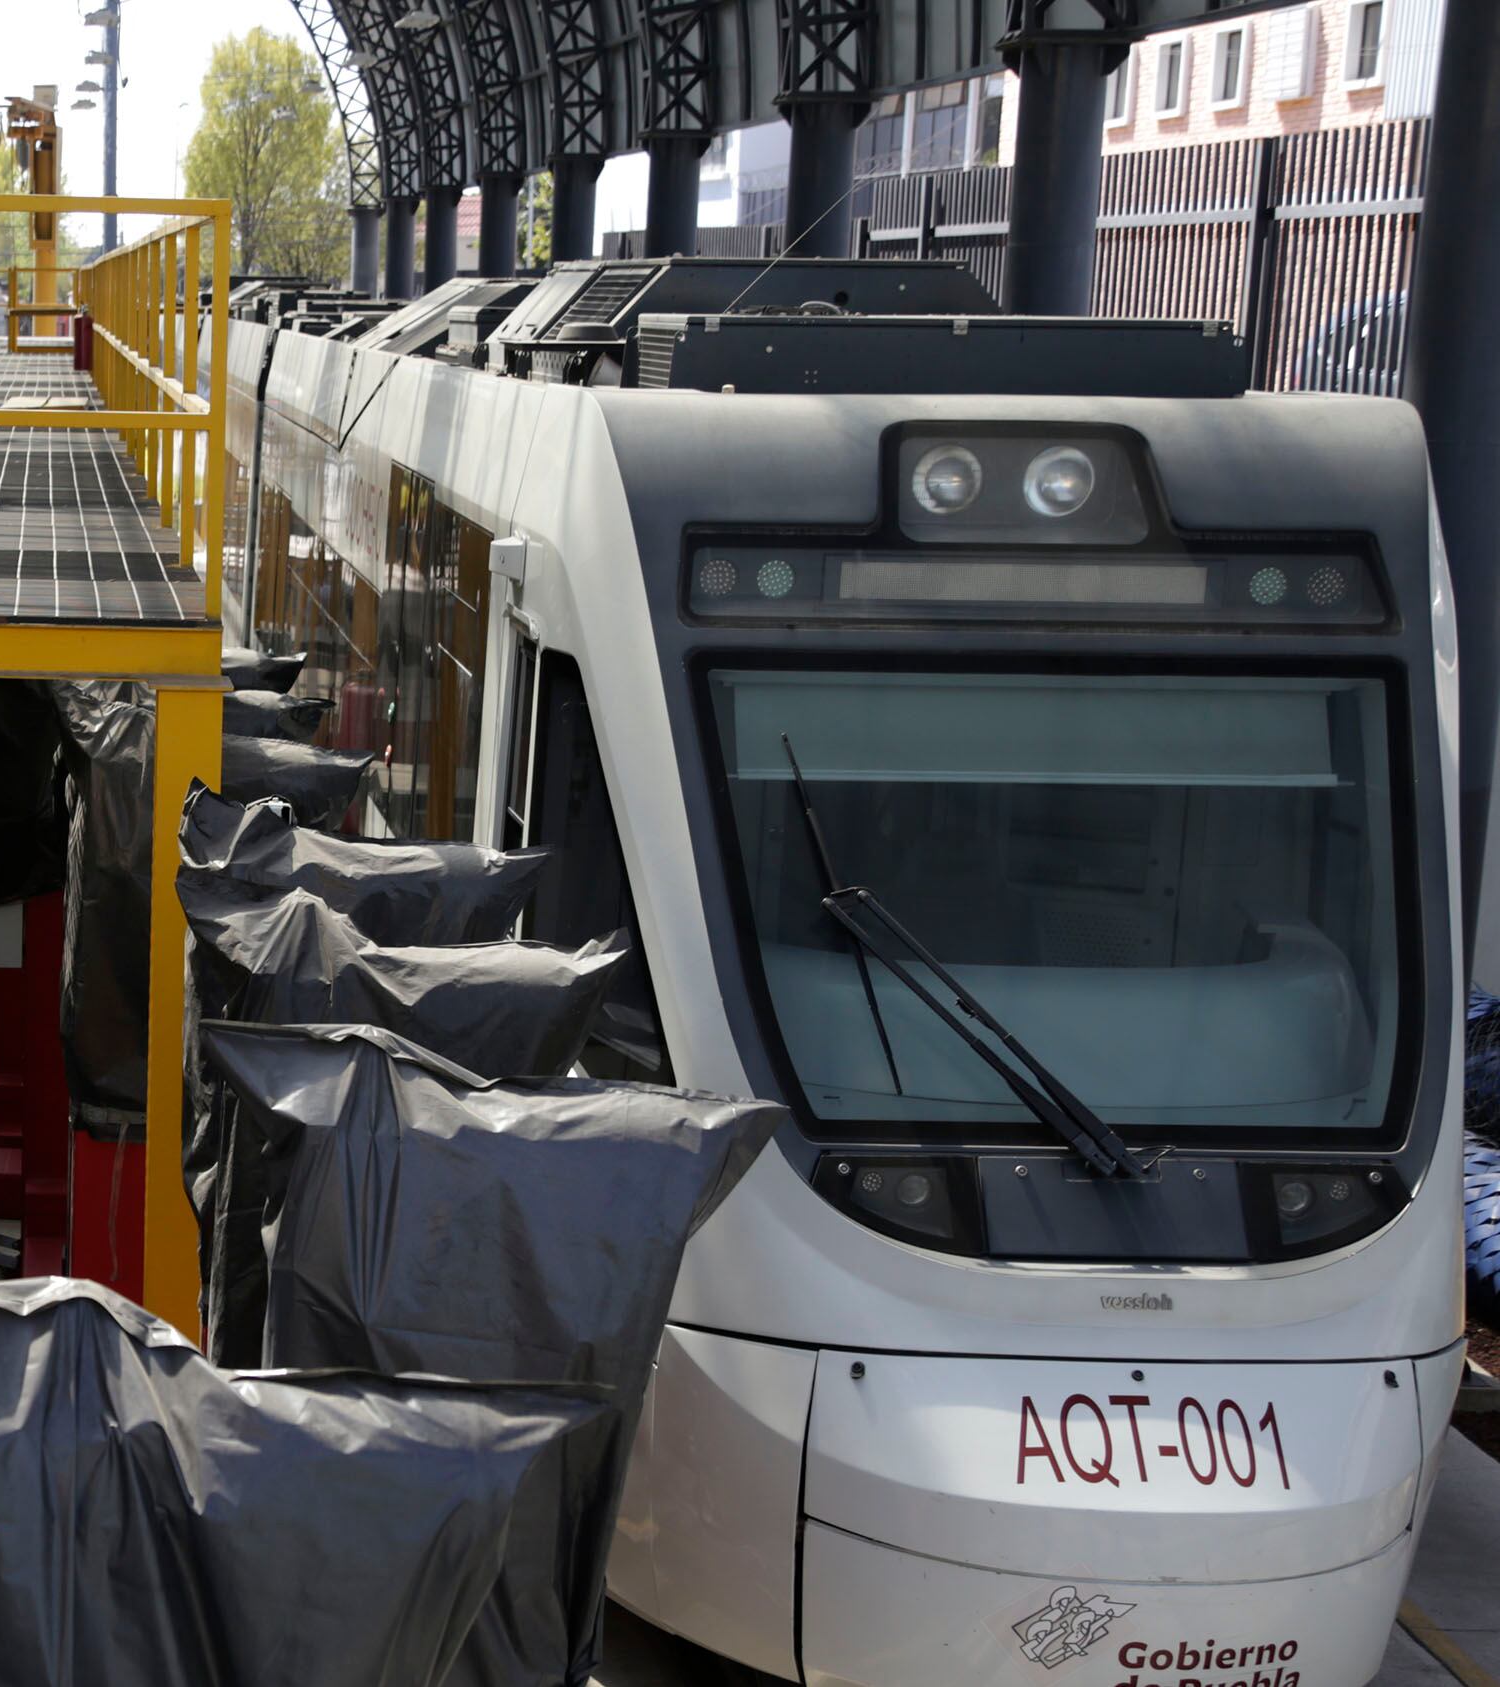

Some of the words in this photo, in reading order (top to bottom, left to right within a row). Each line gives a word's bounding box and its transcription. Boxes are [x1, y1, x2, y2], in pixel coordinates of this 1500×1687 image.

[1100, 1292, 1173, 1310] vossloh
[1017, 1394, 1290, 1490] AQT-001
[1118, 1639, 1298, 1670] Gobierno
[1179, 1668, 1300, 1687] bla
